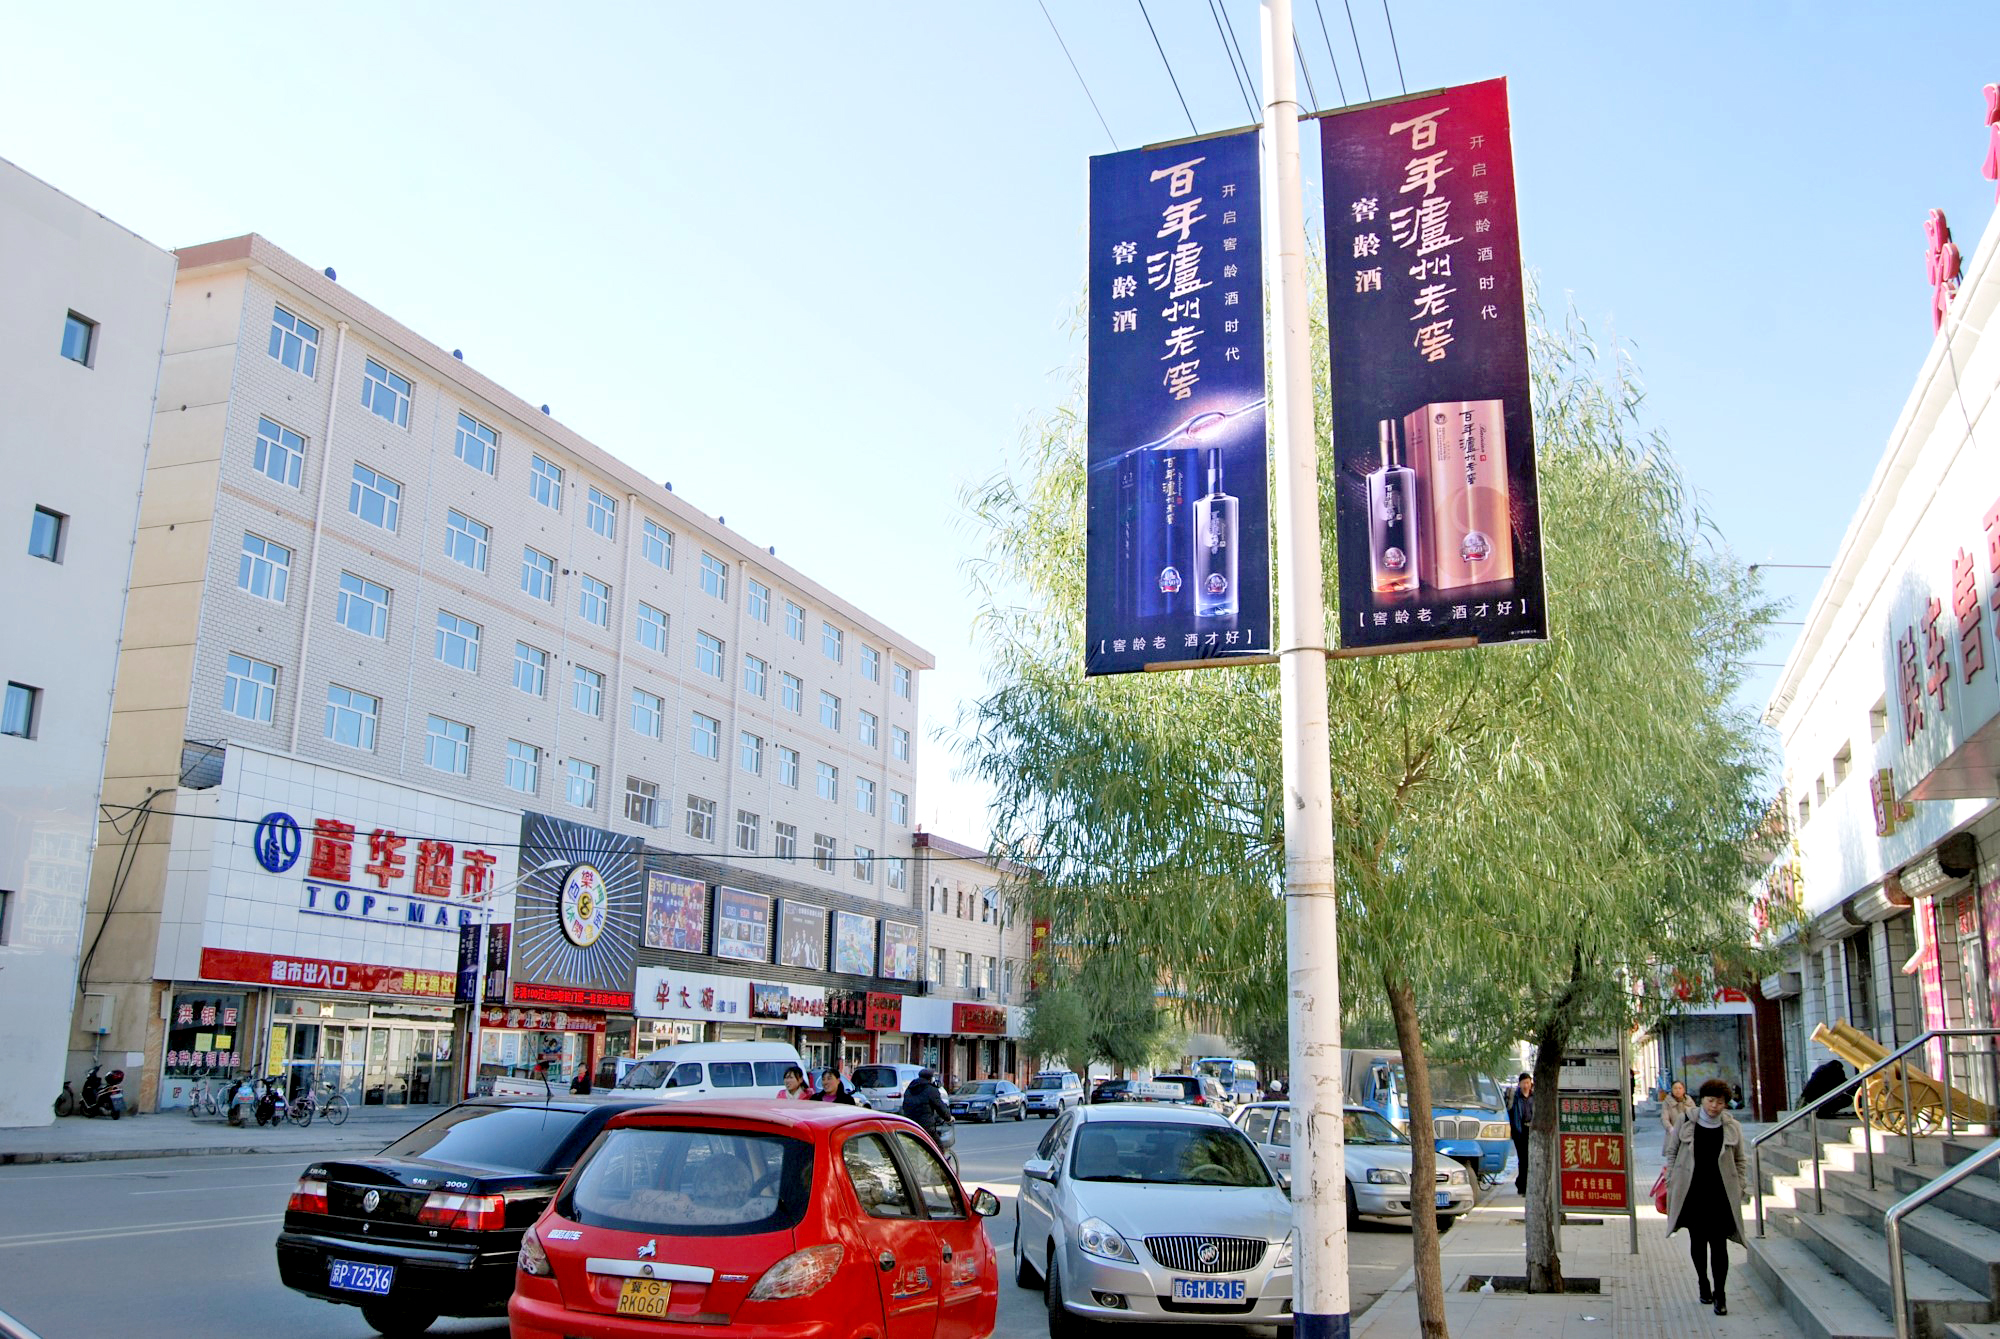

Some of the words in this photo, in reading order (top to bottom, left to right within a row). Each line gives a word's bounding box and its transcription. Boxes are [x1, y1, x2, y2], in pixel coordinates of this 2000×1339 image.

[1469, 135, 1498, 320] 开启窖龄酒时代
[1352, 197, 1383, 293] 窖龄酒
[1112, 241, 1137, 333] 窖龄酒
[1221, 184, 1240, 362] 开启窖龄酒时代
[308, 818, 496, 903] 童华超市
[306, 885, 495, 927] TOP-MART
[271, 959, 348, 987] 超市出入口
[402, 971, 457, 994] 美味缘过
[178, 1004, 238, 1026] 洪银匠
[167, 1050, 240, 1067] 各种纯银制品
[1565, 1138, 1620, 1166] 家俬广场
[445, 1180, 468, 1189] 3000
[618, 1298, 665, 1315] RK060
